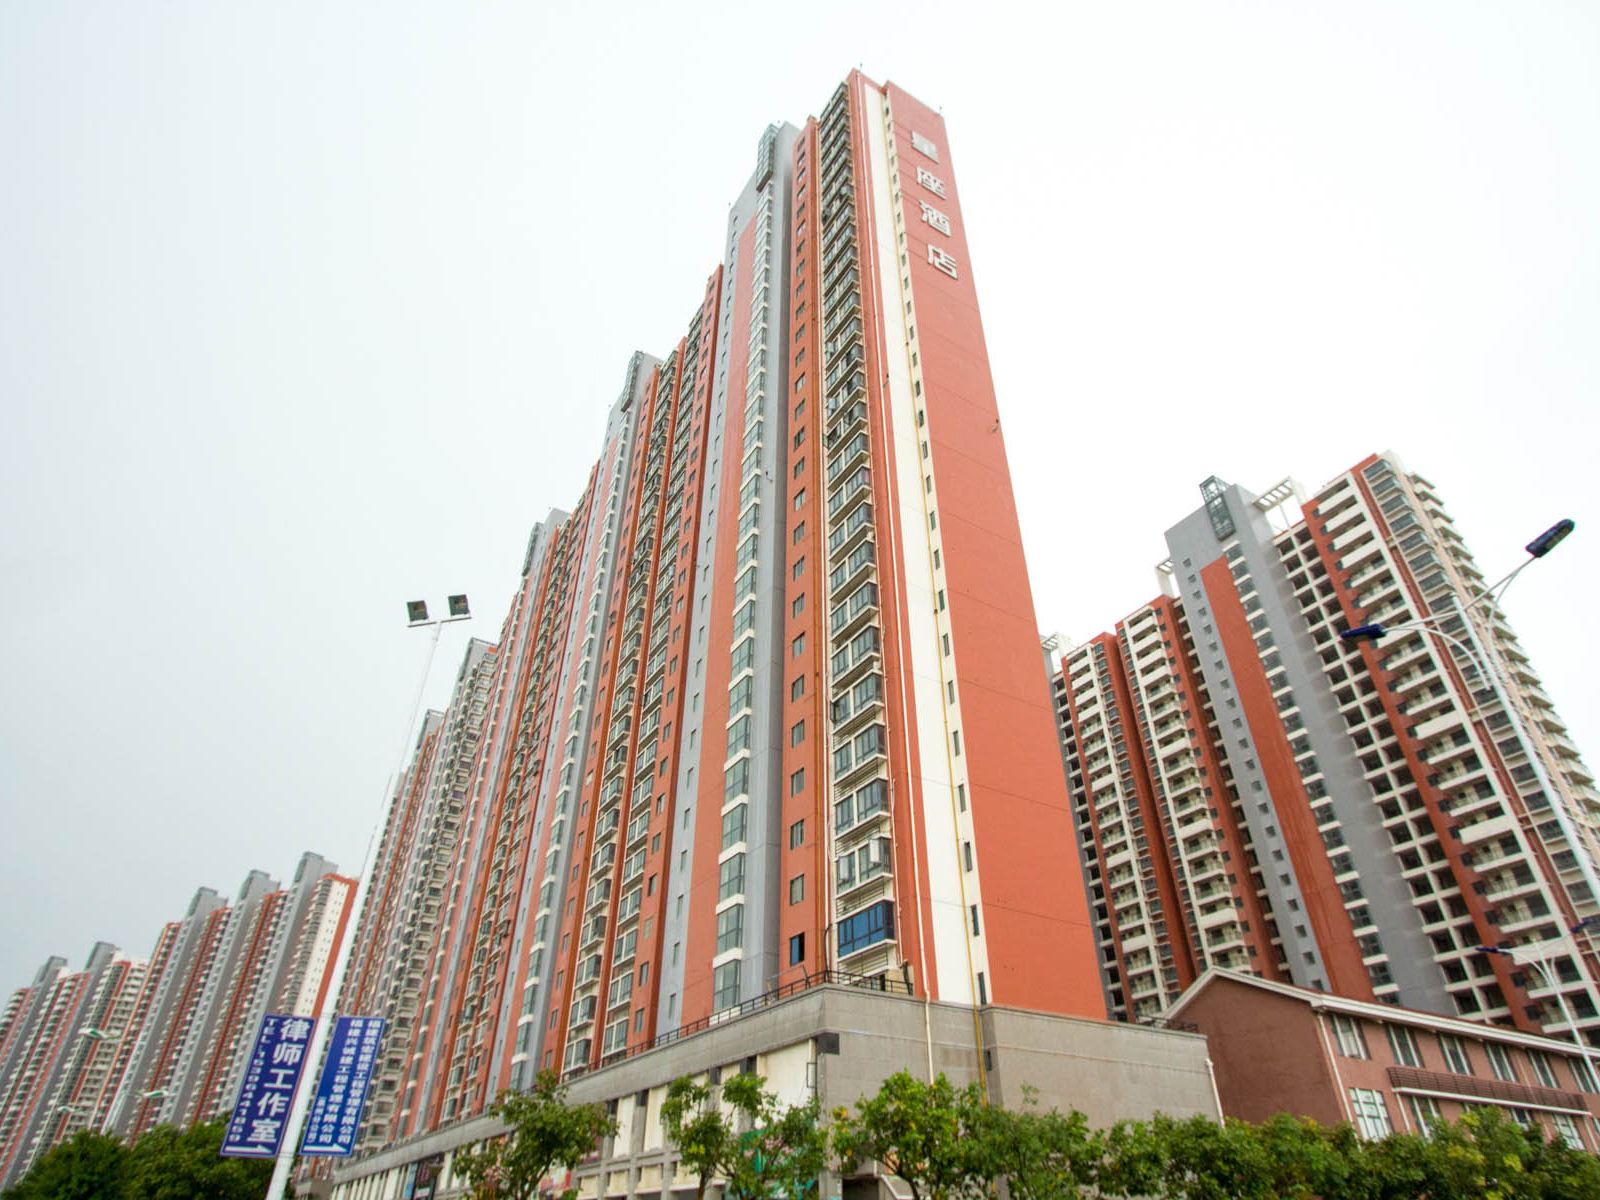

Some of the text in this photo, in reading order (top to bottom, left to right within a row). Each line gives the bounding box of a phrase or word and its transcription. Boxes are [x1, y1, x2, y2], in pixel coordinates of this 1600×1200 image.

[247, 1018, 311, 1143] 律师工作室
